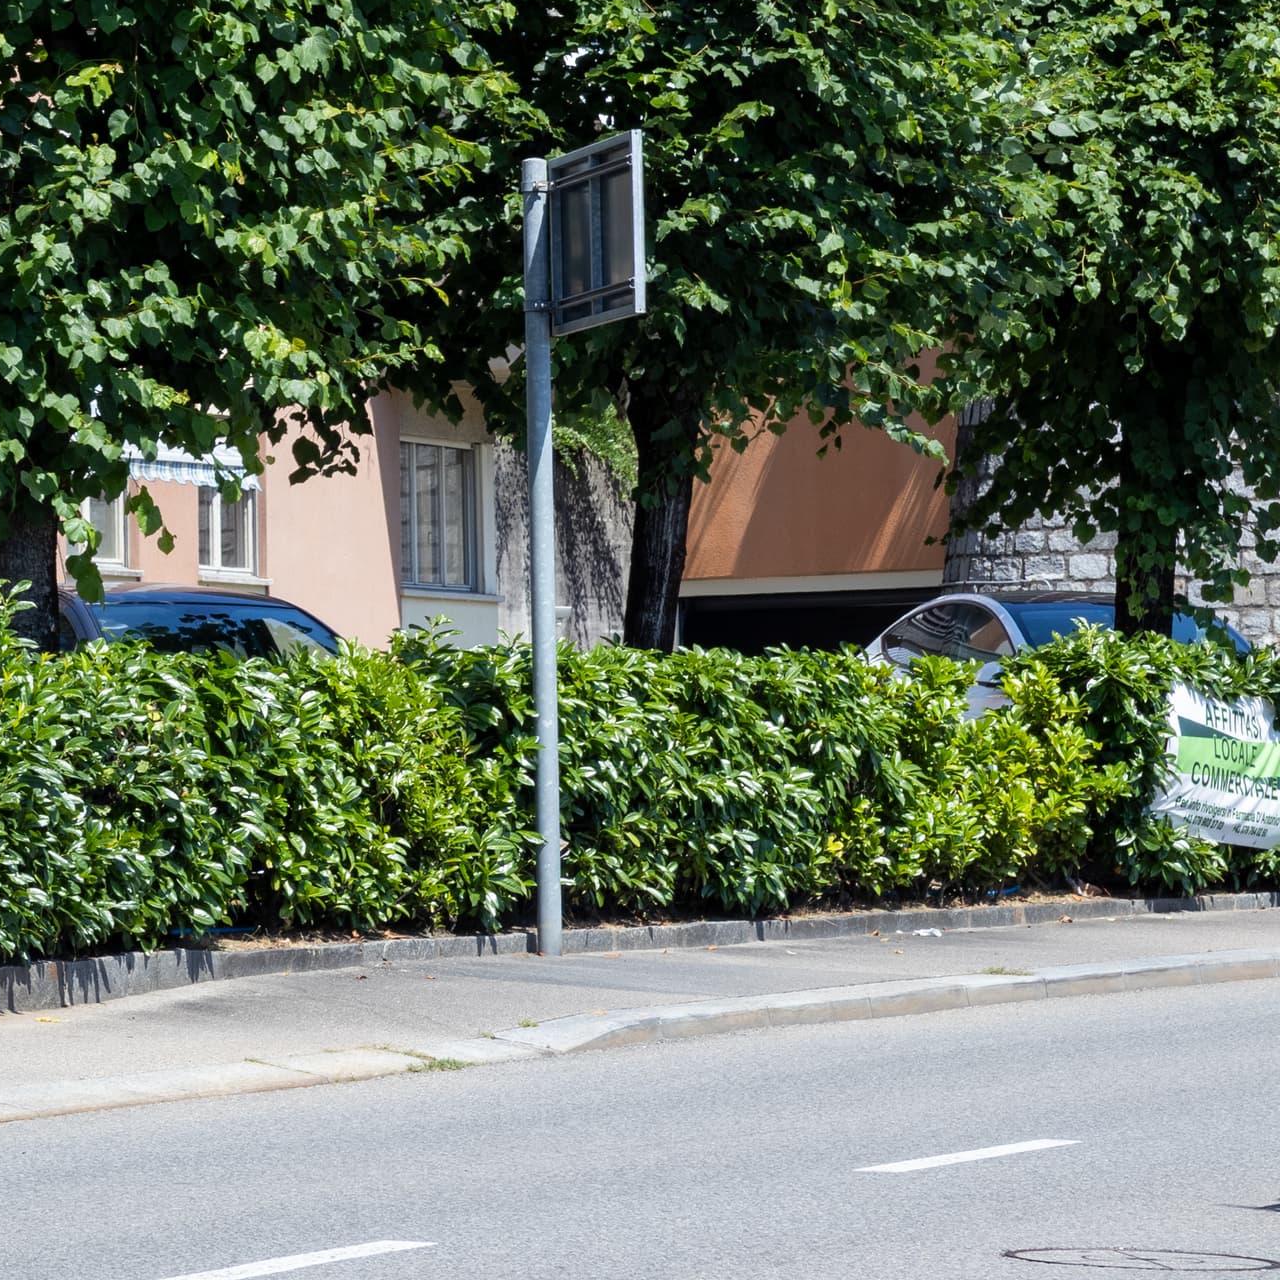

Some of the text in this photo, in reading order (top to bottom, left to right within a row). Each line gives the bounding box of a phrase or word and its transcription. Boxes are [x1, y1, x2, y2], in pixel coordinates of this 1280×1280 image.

[1206, 703, 1262, 740] AFFITTASI
[1213, 734, 1257, 768] LOCALE
[1191, 761, 1278, 800] COMMERCIALE
